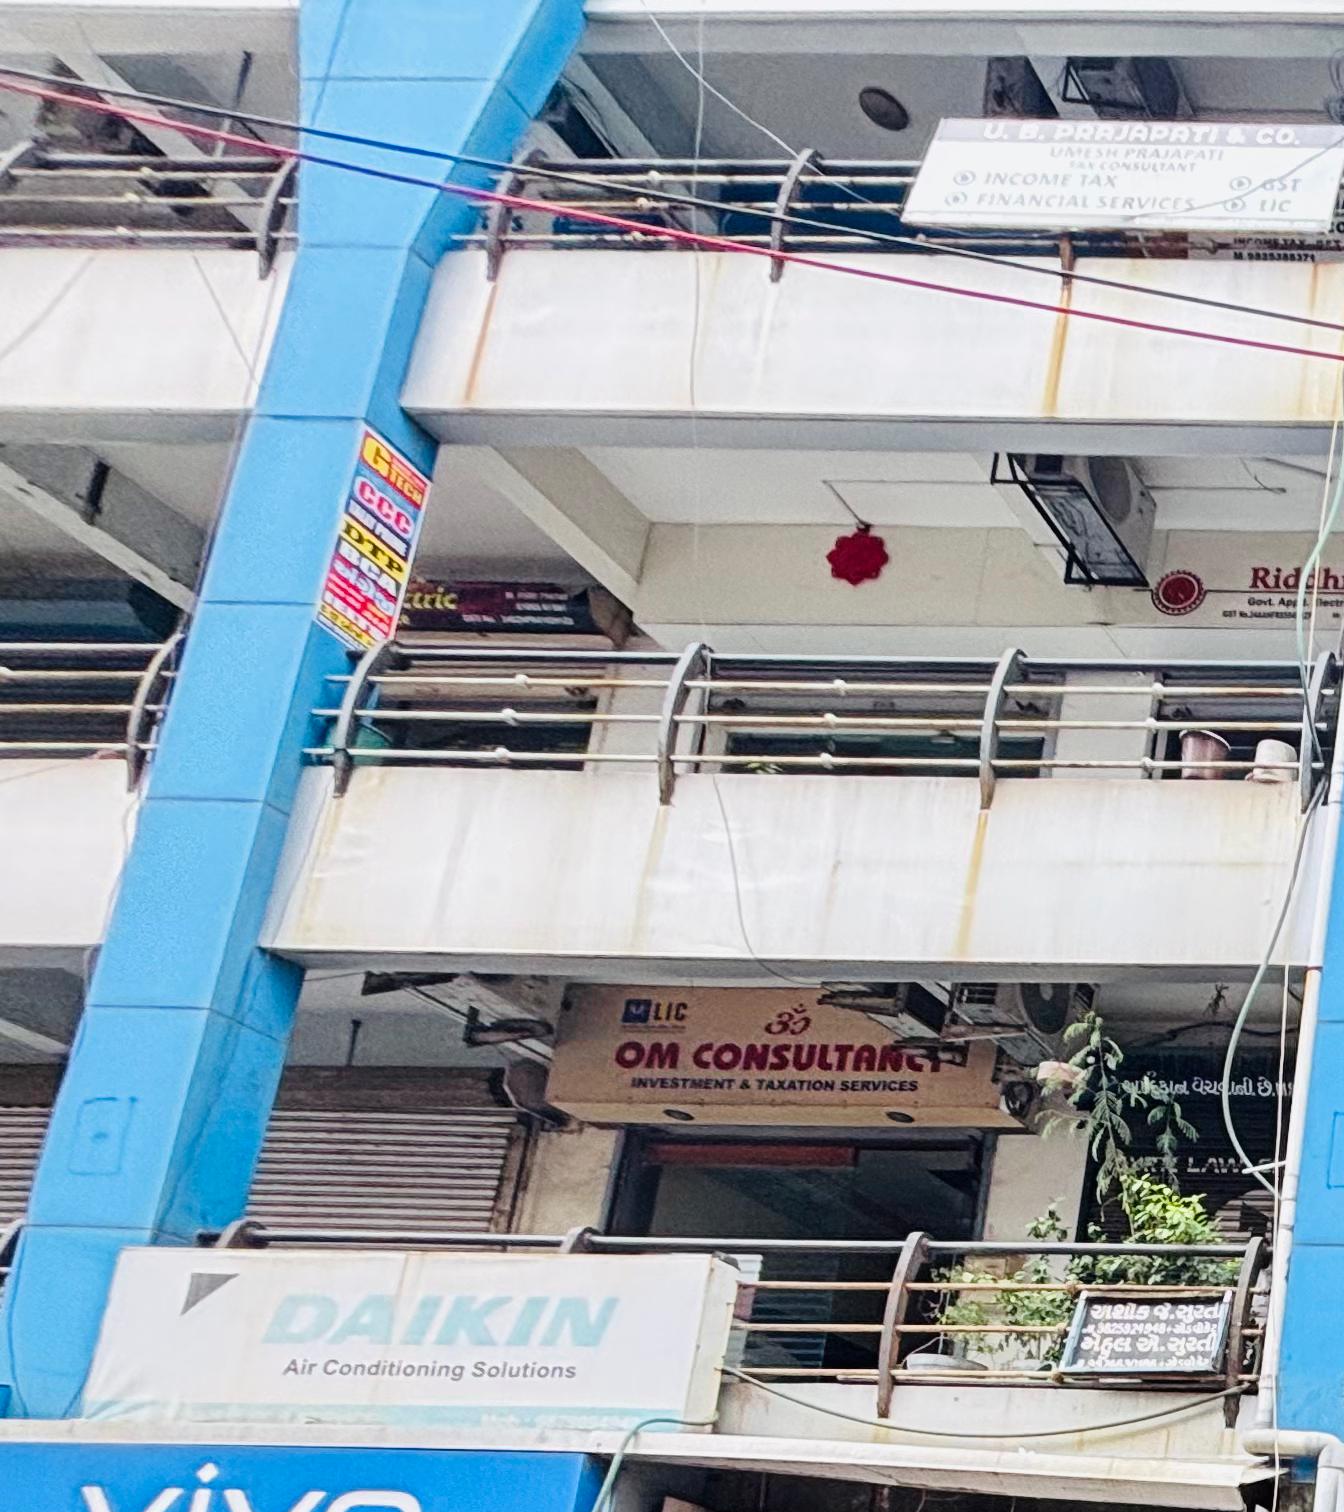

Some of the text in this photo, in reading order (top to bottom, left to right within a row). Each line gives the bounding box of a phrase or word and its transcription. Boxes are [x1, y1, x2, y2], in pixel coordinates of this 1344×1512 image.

[1054, 125, 1220, 143] PRAJAPATI
[1050, 147, 1224, 161] UMESH PRAJAPATI
[1100, 162, 1195, 173] CONSULTANT
[985, 172, 1117, 189] INCOME TAX
[1261, 178, 1302, 192] GST
[975, 193, 1195, 211] FINANCIAL SERVICES
[1259, 199, 1292, 213] LIC
[355, 477, 414, 539] CCC
[343, 520, 405, 574] DTP
[403, 585, 459, 611] ctric
[653, 1001, 687, 1022] LIC
[615, 1042, 680, 1069] OM
[632, 1077, 919, 1093] INVESTMENT & TAXATION SERVICES
[262, 1292, 620, 1347] DAIKIN
[283, 1358, 577, 1383] Air Conditioning Solutions
